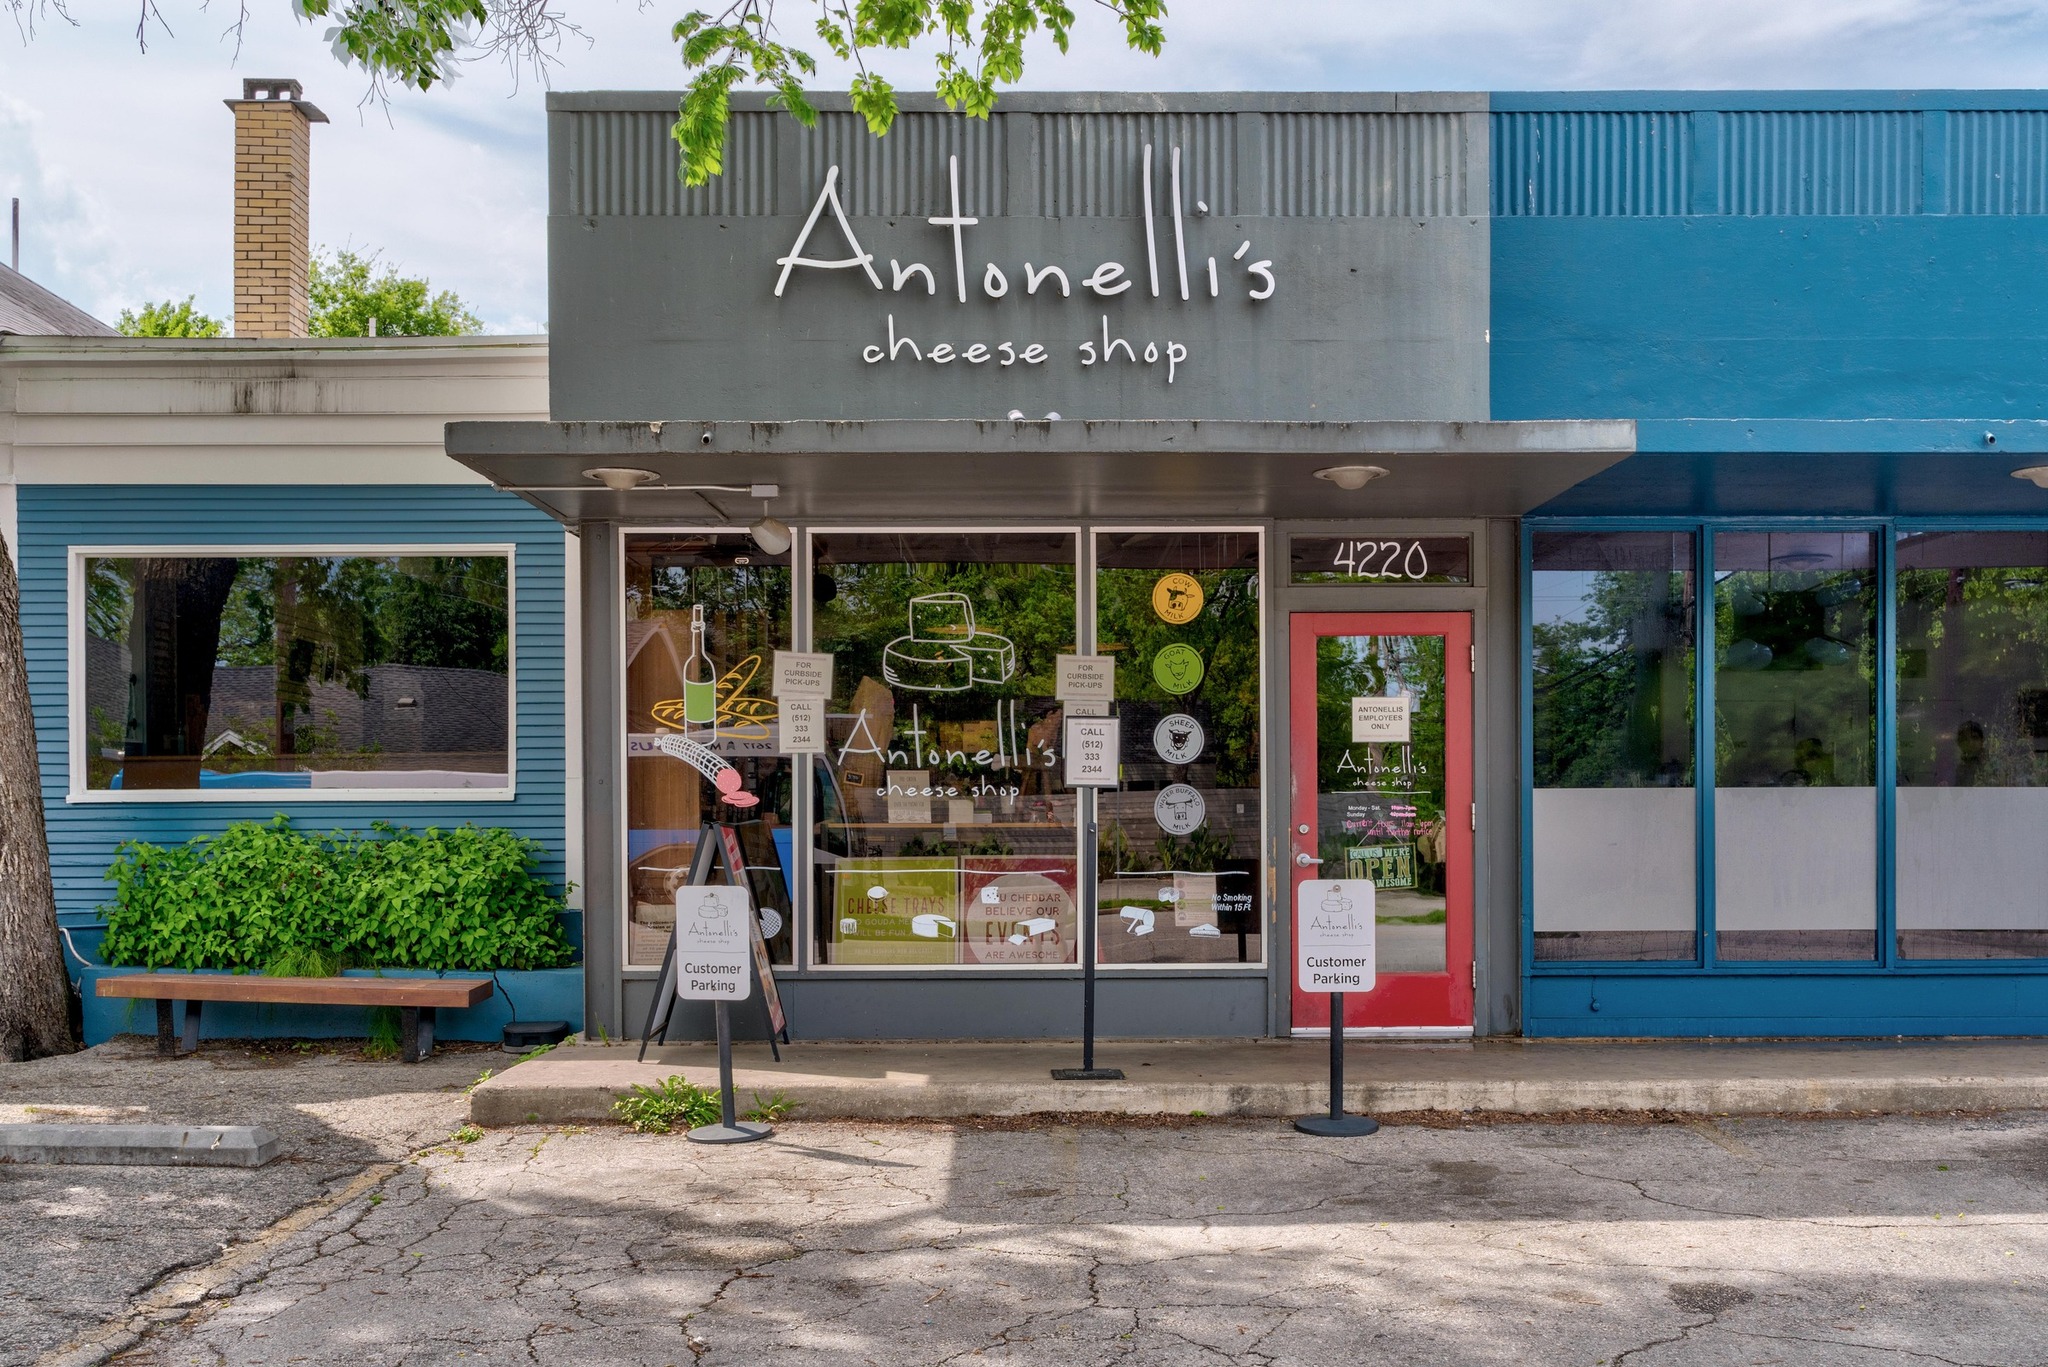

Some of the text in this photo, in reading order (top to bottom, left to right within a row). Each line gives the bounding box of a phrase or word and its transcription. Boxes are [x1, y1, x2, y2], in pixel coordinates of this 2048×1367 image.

[775, 143, 1277, 303] Antonelli's
[863, 313, 1188, 384] cheese shop
[1333, 540, 1428, 579] 4220
[1172, 577, 1192, 588] COW
[1164, 608, 1184, 619] MILK
[1163, 648, 1185, 660] GOAT
[795, 661, 812, 669] FOR
[784, 669, 822, 678] CURBSIDE
[785, 678, 820, 687] PICK-UPS
[1068, 681, 1103, 689] PICK-UPS
[1172, 679, 1193, 690] MILK
[790, 703, 812, 711] CALL
[1075, 708, 1097, 716] CALL
[791, 714, 811, 722] (512)
[1169, 719, 1195, 730] SHEEP
[838, 699, 1056, 768] Antonelli's
[1080, 728, 1105, 736] CALL
[1081, 740, 1104, 750] (512)
[1084, 753, 1100, 761] 333
[1164, 748, 1187, 760] MILK
[1336, 745, 1427, 774] Antonelli's
[1081, 765, 1103, 773] 2344
[1352, 777, 1412, 789] cheese shop
[876, 775, 959, 797] cheese
[972, 775, 1020, 805] shop
[1158, 787, 1201, 809] WATER BUFFALO
[1172, 822, 1191, 831] MILK
[1350, 857, 1411, 880] OPEN
[1374, 879, 1412, 888] WESOME
[1010, 893, 1062, 903] CHEDDAR
[1211, 893, 1252, 904] No Smoking
[847, 896, 945, 915] CHEESE TRAYS
[1211, 902, 1232, 912] Within
[985, 906, 1060, 917] BELIEVE OUR
[866, 918, 896, 926] GOUDA
[1310, 914, 1363, 930] Antonelli's
[688, 920, 738, 936] Antonelli's
[875, 929, 885, 937] BE
[889, 929, 906, 937] FUN
[984, 951, 1004, 960] ARE
[1306, 956, 1367, 968] Customer
[684, 962, 742, 974] Customer
[1313, 973, 1360, 986] Parking
[691, 979, 736, 993] Parking
